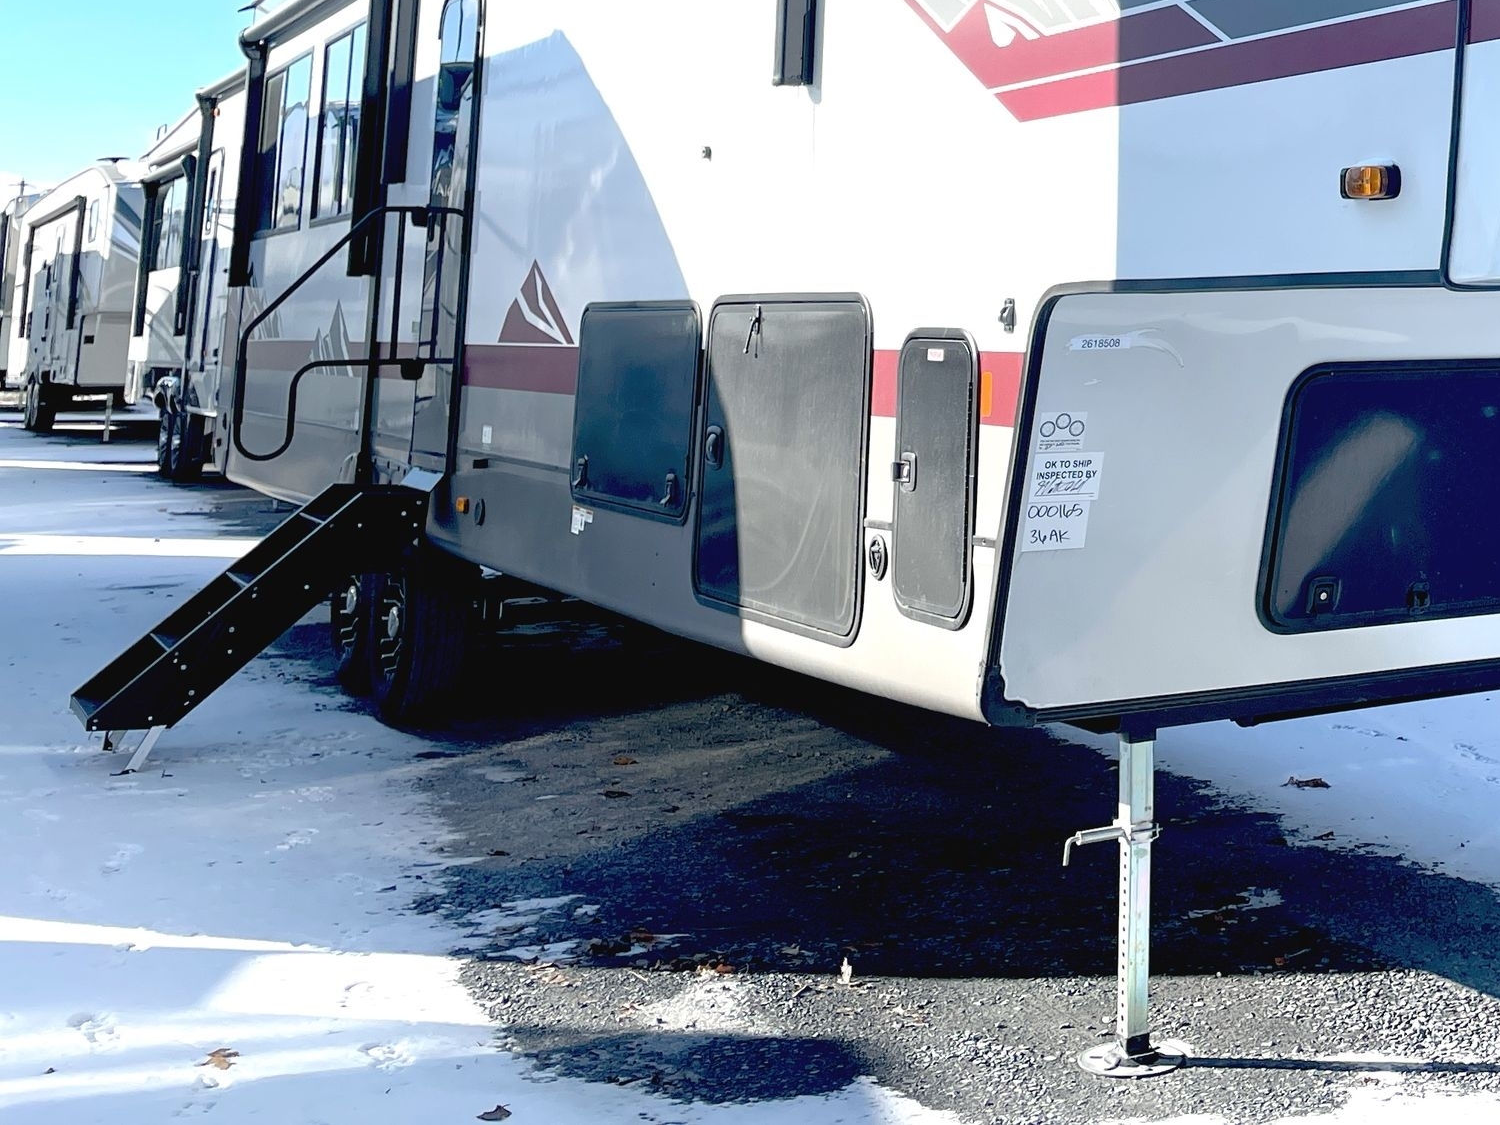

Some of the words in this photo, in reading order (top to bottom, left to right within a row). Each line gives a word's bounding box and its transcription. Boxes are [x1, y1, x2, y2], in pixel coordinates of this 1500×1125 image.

[1081, 338, 1121, 349] 2618508
[1045, 460, 1057, 469] OK
[1060, 460, 1071, 468] TO
[1072, 459, 1093, 468] SHIP
[1036, 470, 1084, 480] INSPECTED
[1085, 470, 1098, 479] BY
[1028, 503, 1083, 519] 000165
